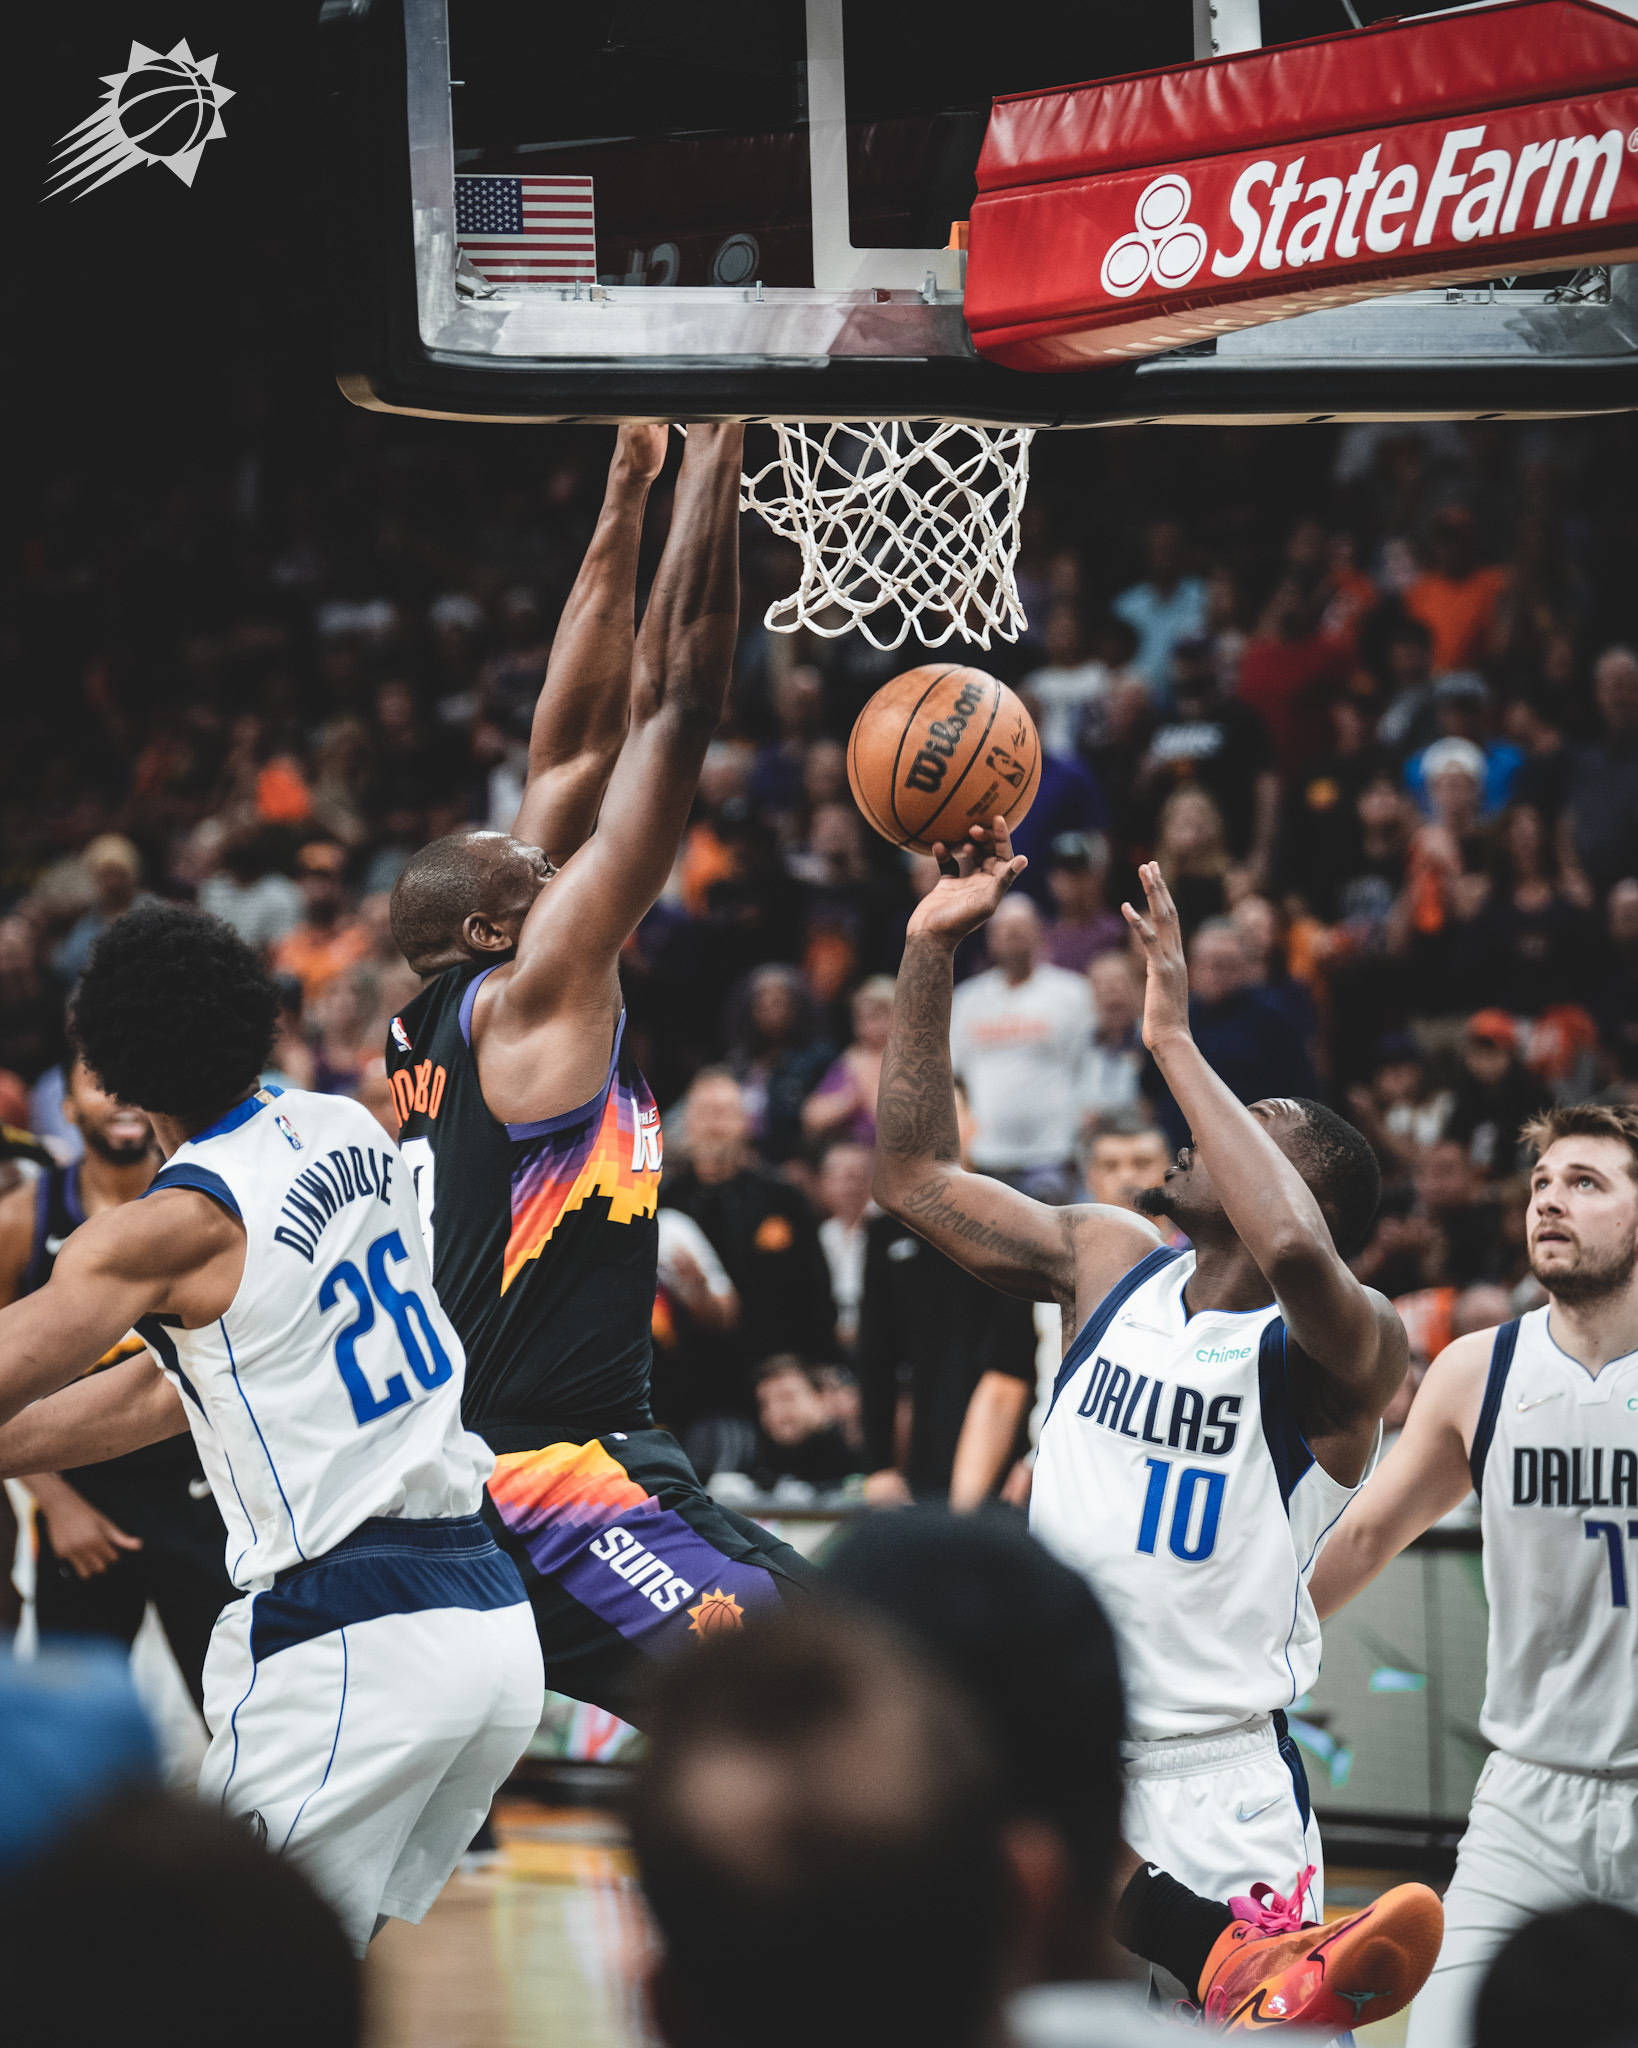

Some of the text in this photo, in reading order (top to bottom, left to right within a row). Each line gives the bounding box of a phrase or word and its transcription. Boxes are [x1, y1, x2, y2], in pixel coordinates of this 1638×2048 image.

[904, 683, 985, 793] Wilson
[274, 1146, 393, 1264] DINWIDDIE
[318, 1228, 453, 1427] 26
[1196, 1347, 1251, 1363] chime
[1076, 1356, 1244, 1457] DALLAS
[1135, 1456, 1229, 1564] 10
[590, 1526, 694, 1612] SUNS
